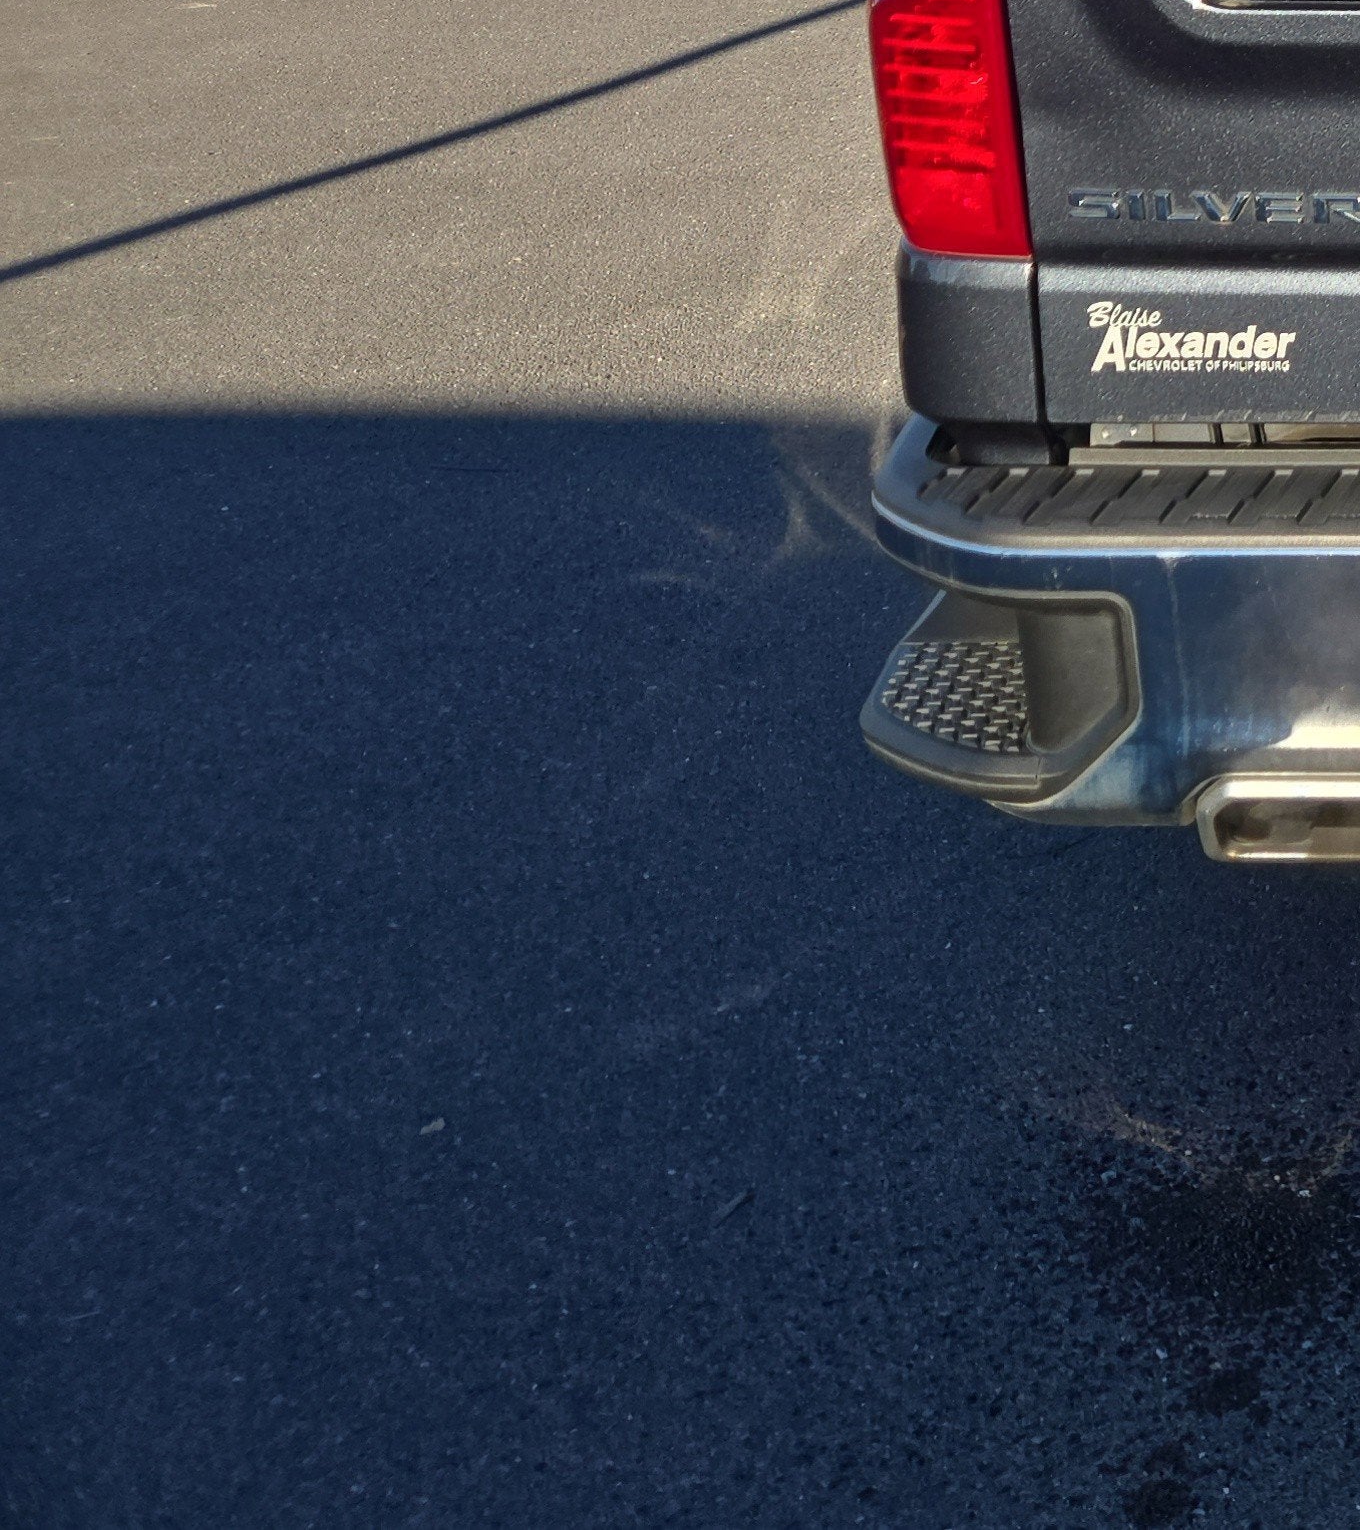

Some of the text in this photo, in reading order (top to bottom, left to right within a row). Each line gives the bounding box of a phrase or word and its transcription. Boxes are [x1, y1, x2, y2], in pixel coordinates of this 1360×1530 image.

[1086, 301, 1162, 329] Blaise
[1091, 325, 1296, 372] Alexander
[1129, 359, 1202, 372] CHEVROLET
[1204, 359, 1221, 372] OF
